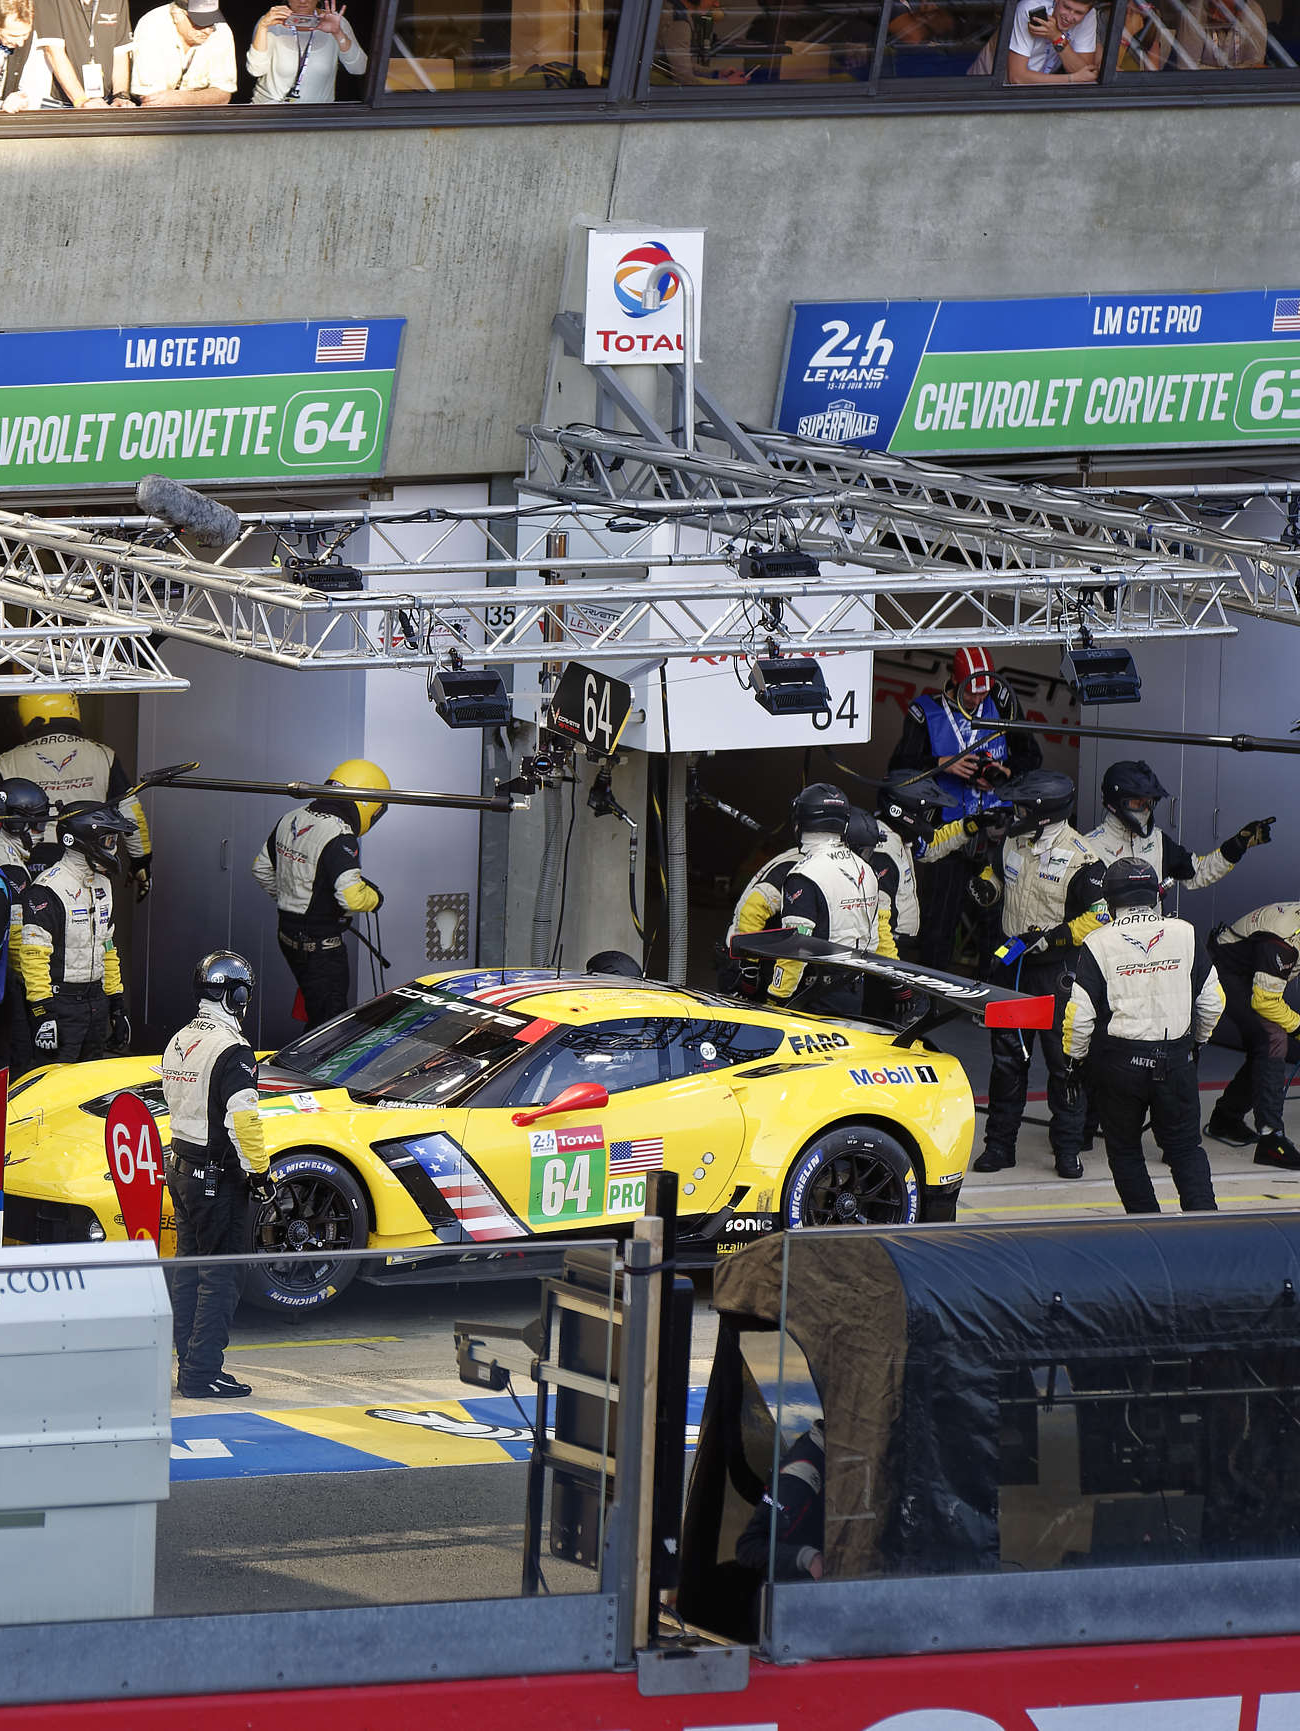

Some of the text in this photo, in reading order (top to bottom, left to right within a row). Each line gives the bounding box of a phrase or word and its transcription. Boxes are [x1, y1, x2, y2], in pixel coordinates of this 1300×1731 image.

[1093, 304, 1202, 335] LM GTE PRO
[125, 336, 241, 368] LM GTE PRO
[596, 330, 684, 352] TOTAL
[808, 319, 894, 367] 24h
[803, 368, 885, 382] LE MANS
[914, 372, 1234, 432] CHEVROLET CORVETTE
[118, 404, 277, 460] CORVETTE
[293, 401, 367, 455] 64
[799, 409, 878, 442] SUPERFINALE
[488, 606, 516, 627] 35
[570, 617, 582, 627] LE
[583, 673, 613, 750] 64
[1111, 913, 1165, 928] HORTON
[1115, 957, 1182, 972] CORVETTE
[1115, 964, 1180, 977] RACING
[391, 986, 528, 1028] CORVETTE
[788, 1032, 850, 1055] FARO
[849, 1066, 915, 1086] Mobil
[558, 1133, 603, 1147] TOTAL
[112, 1123, 158, 1186] 64
[285, 1160, 335, 1174] MICHELIN
[540, 1153, 592, 1217] 64
[608, 1181, 646, 1210] PRO
[790, 1153, 821, 1221] MICHELIN
[725, 1218, 773, 1233] sonic
[270, 1291, 318, 1306] MICHELIN
